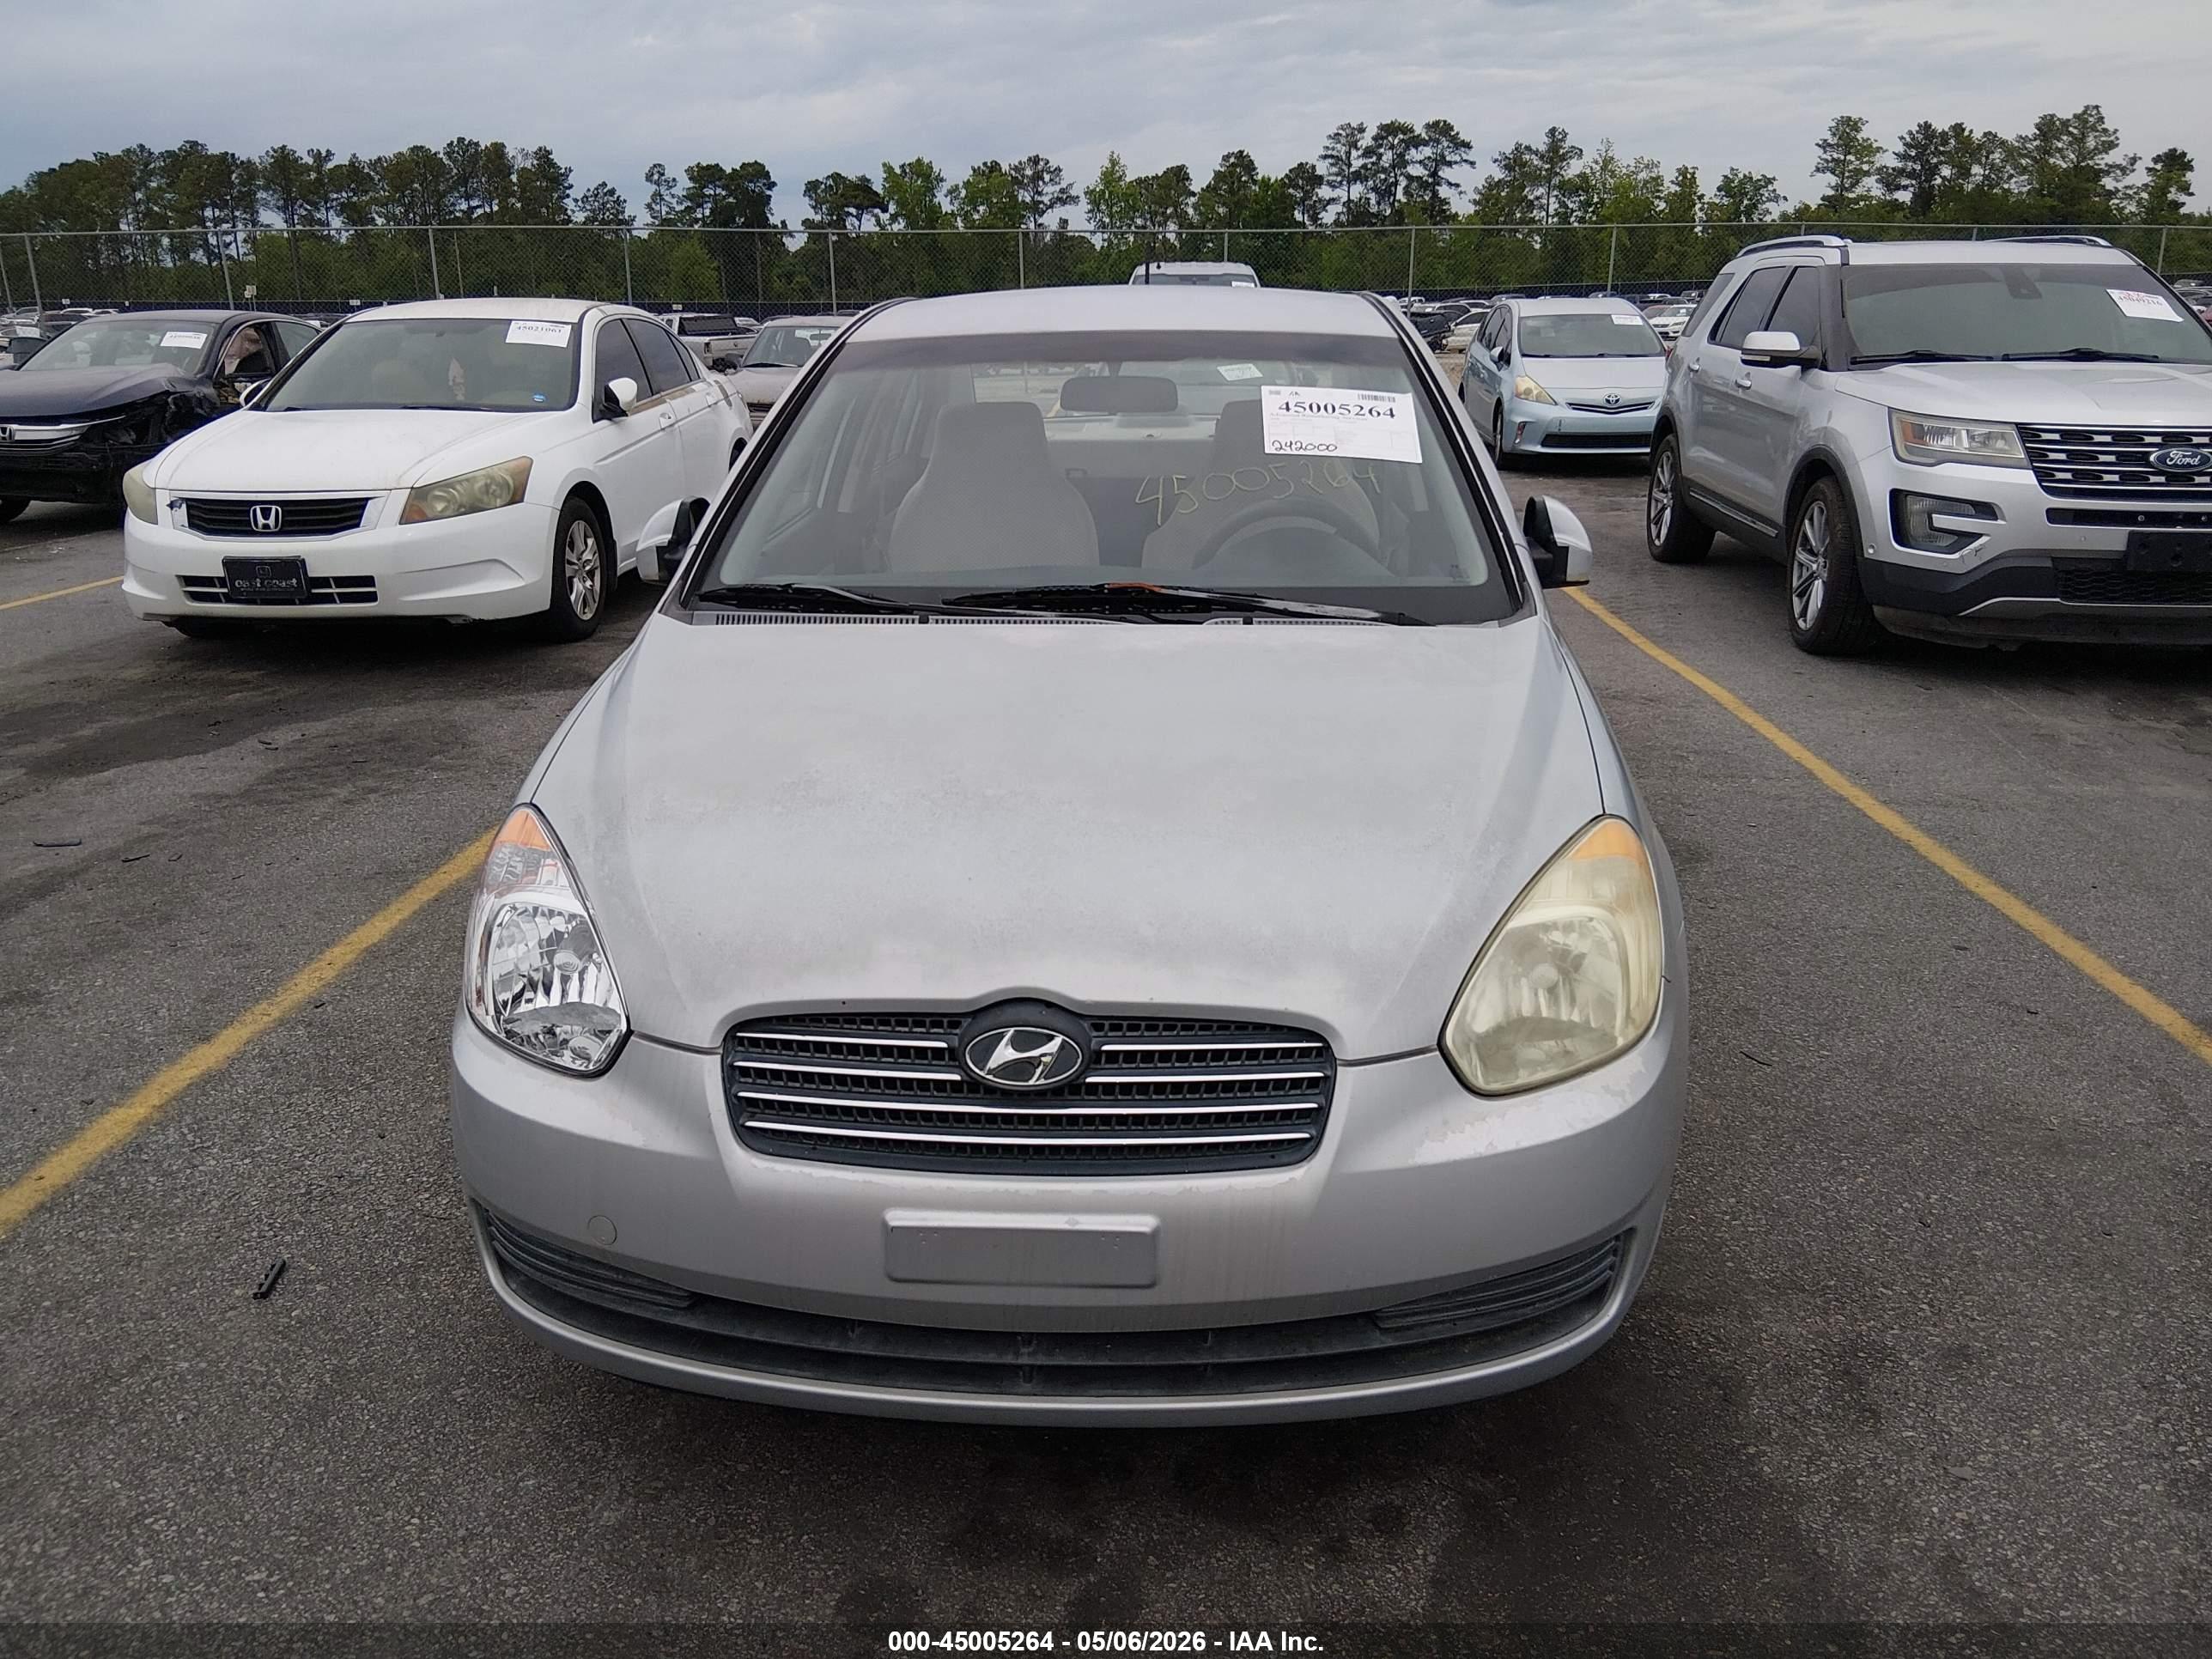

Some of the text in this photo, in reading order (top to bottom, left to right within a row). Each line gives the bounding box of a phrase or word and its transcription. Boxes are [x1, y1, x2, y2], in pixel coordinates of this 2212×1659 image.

[1278, 400, 1396, 419] 45005264
[1272, 439, 1338, 453] 242000
[2166, 450, 2201, 465] Ford
[1136, 460, 1381, 526] 45005264
